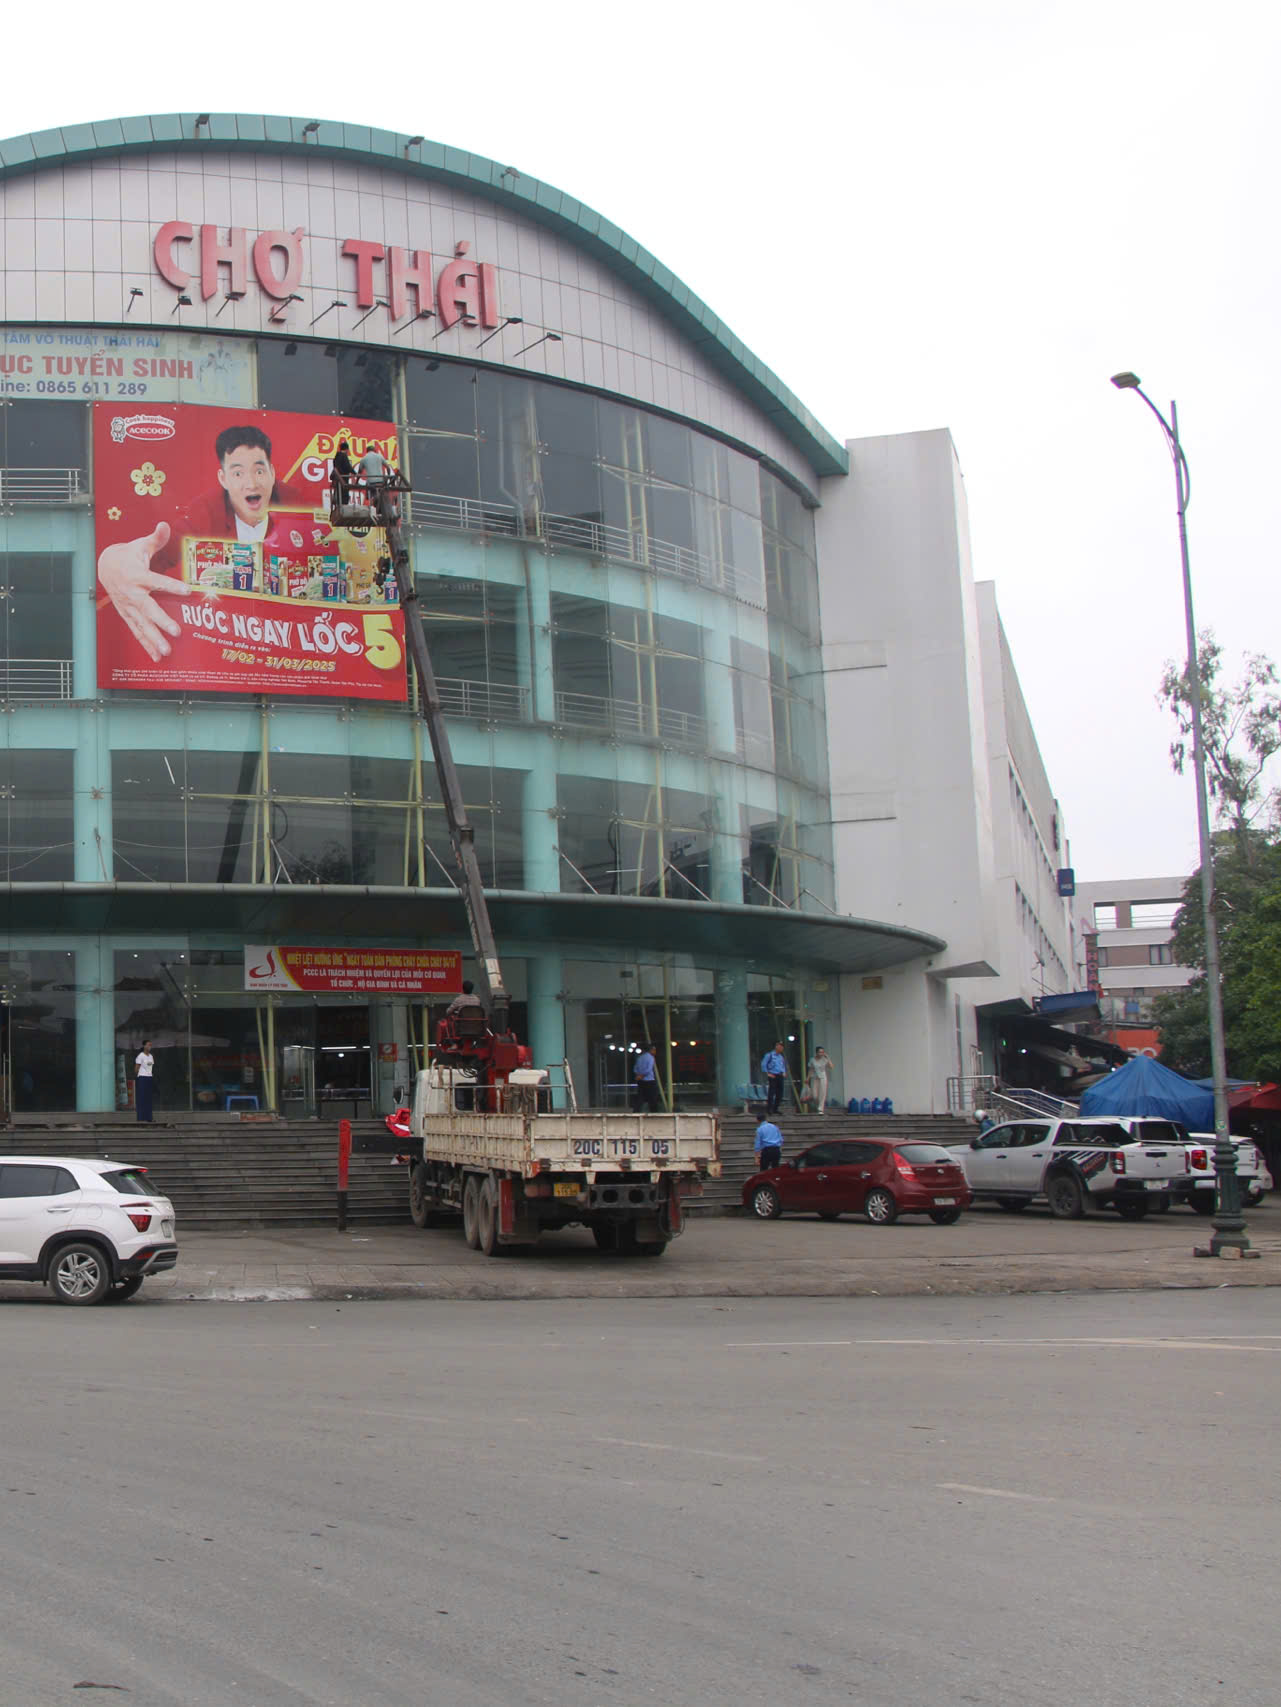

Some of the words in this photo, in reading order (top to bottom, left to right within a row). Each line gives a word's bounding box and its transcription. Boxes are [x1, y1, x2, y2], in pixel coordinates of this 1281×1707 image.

[154, 220, 305, 323] CHỢ
[342, 240, 498, 329] THÁI
[41, 349, 124, 377] TUYỂN
[132, 358, 194, 379] SINH
[36, 380, 77, 394] 0865
[81, 381, 110, 395] 611
[117, 383, 148, 396] 289
[240, 575, 247, 589] 1
[328, 583, 334, 597] 1
[181, 602, 229, 634] RƯỚC
[232, 613, 292, 649] NGAY
[297, 610, 364, 656] LỐC
[362, 614, 403, 670] 5
[221, 648, 255, 664] 17/02
[264, 656, 337, 672] 31/03/2025
[573, 1140, 601, 1155] 20C
[612, 1140, 638, 1155] 115
[651, 1140, 669, 1155] 05
